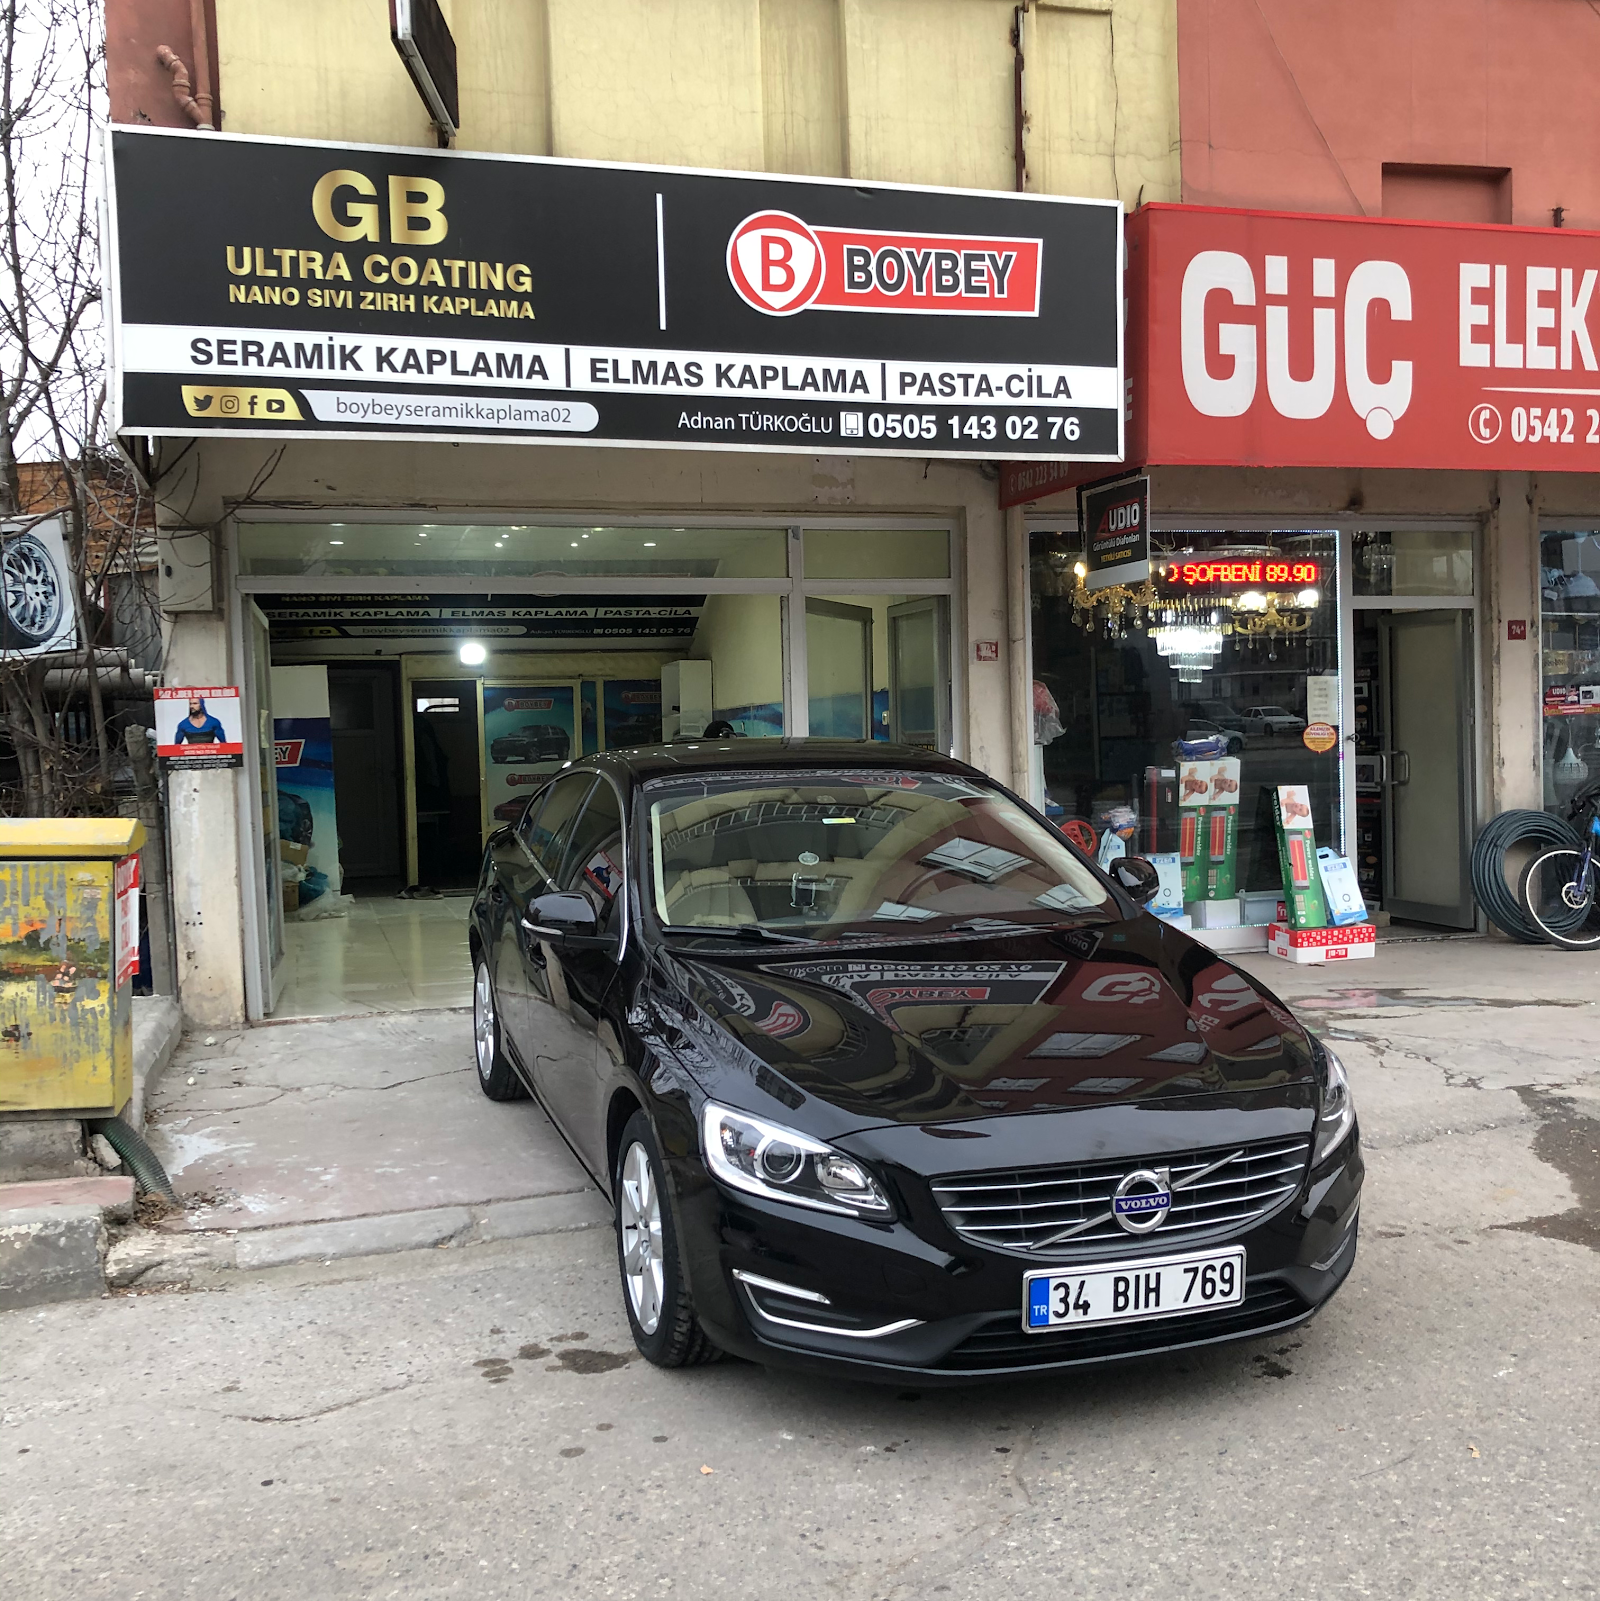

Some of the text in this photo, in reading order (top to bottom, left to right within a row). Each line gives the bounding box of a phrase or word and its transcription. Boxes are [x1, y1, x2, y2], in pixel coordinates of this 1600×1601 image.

[312, 169, 448, 246] GB
[226, 245, 533, 293] ULTRA COATING
[761, 234, 796, 292] B
[844, 245, 1016, 298] BOYBEY
[229, 284, 536, 320] NANO SIVI ZIRH KAPLAMA
[190, 336, 549, 381] SERAMİK KAPLAMA
[1181, 250, 1413, 440] GÜÇ
[589, 357, 870, 394] ELMAS KAPLAMA
[900, 367, 1072, 399] PASTA-CİLA
[335, 396, 572, 425] boybeyseramikkaplama02
[678, 411, 832, 434] Adnan TÜRKOĞLU
[868, 413, 1081, 441] 0505 143 02 76
[1511, 406, 1574, 443] 0542
[1183, 561, 1261, 585] ŞOFBENİ
[1266, 564, 1315, 582] 89.90
[350, 609, 431, 618] KAPLAMA
[450, 609, 589, 617] ELMAS KAPLAMA
[1119, 1195, 1168, 1210] VOLVO
[1052, 1261, 1235, 1319] 34 BIH 769
[1033, 1305, 1048, 1316] TR
